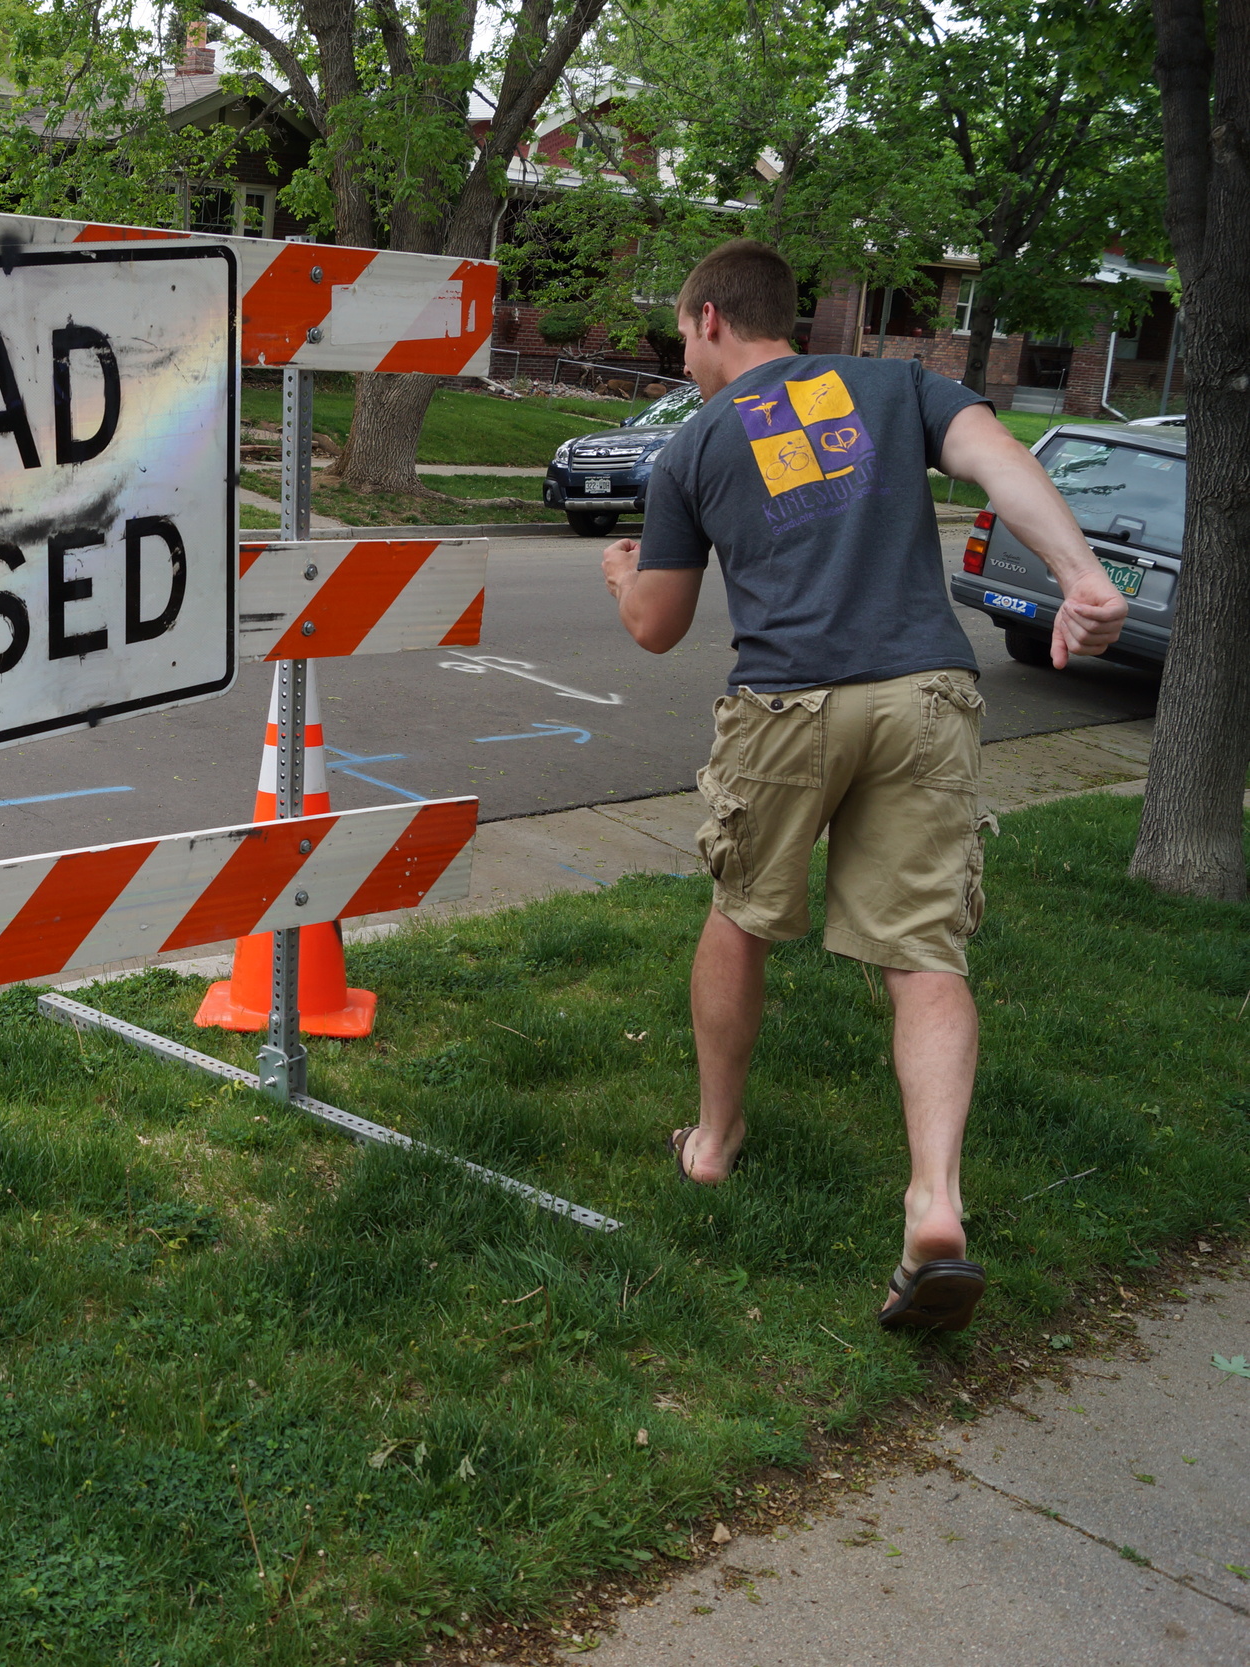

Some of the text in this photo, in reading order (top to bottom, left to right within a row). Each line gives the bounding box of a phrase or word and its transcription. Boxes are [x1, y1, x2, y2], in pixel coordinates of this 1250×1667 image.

[761, 457, 884, 524] KINESIOLOG
[771, 510, 815, 536] Graduate
[990, 558, 1027, 574] VOLVO
[1106, 566, 1139, 588] 1047
[992, 594, 1027, 613] 2012
